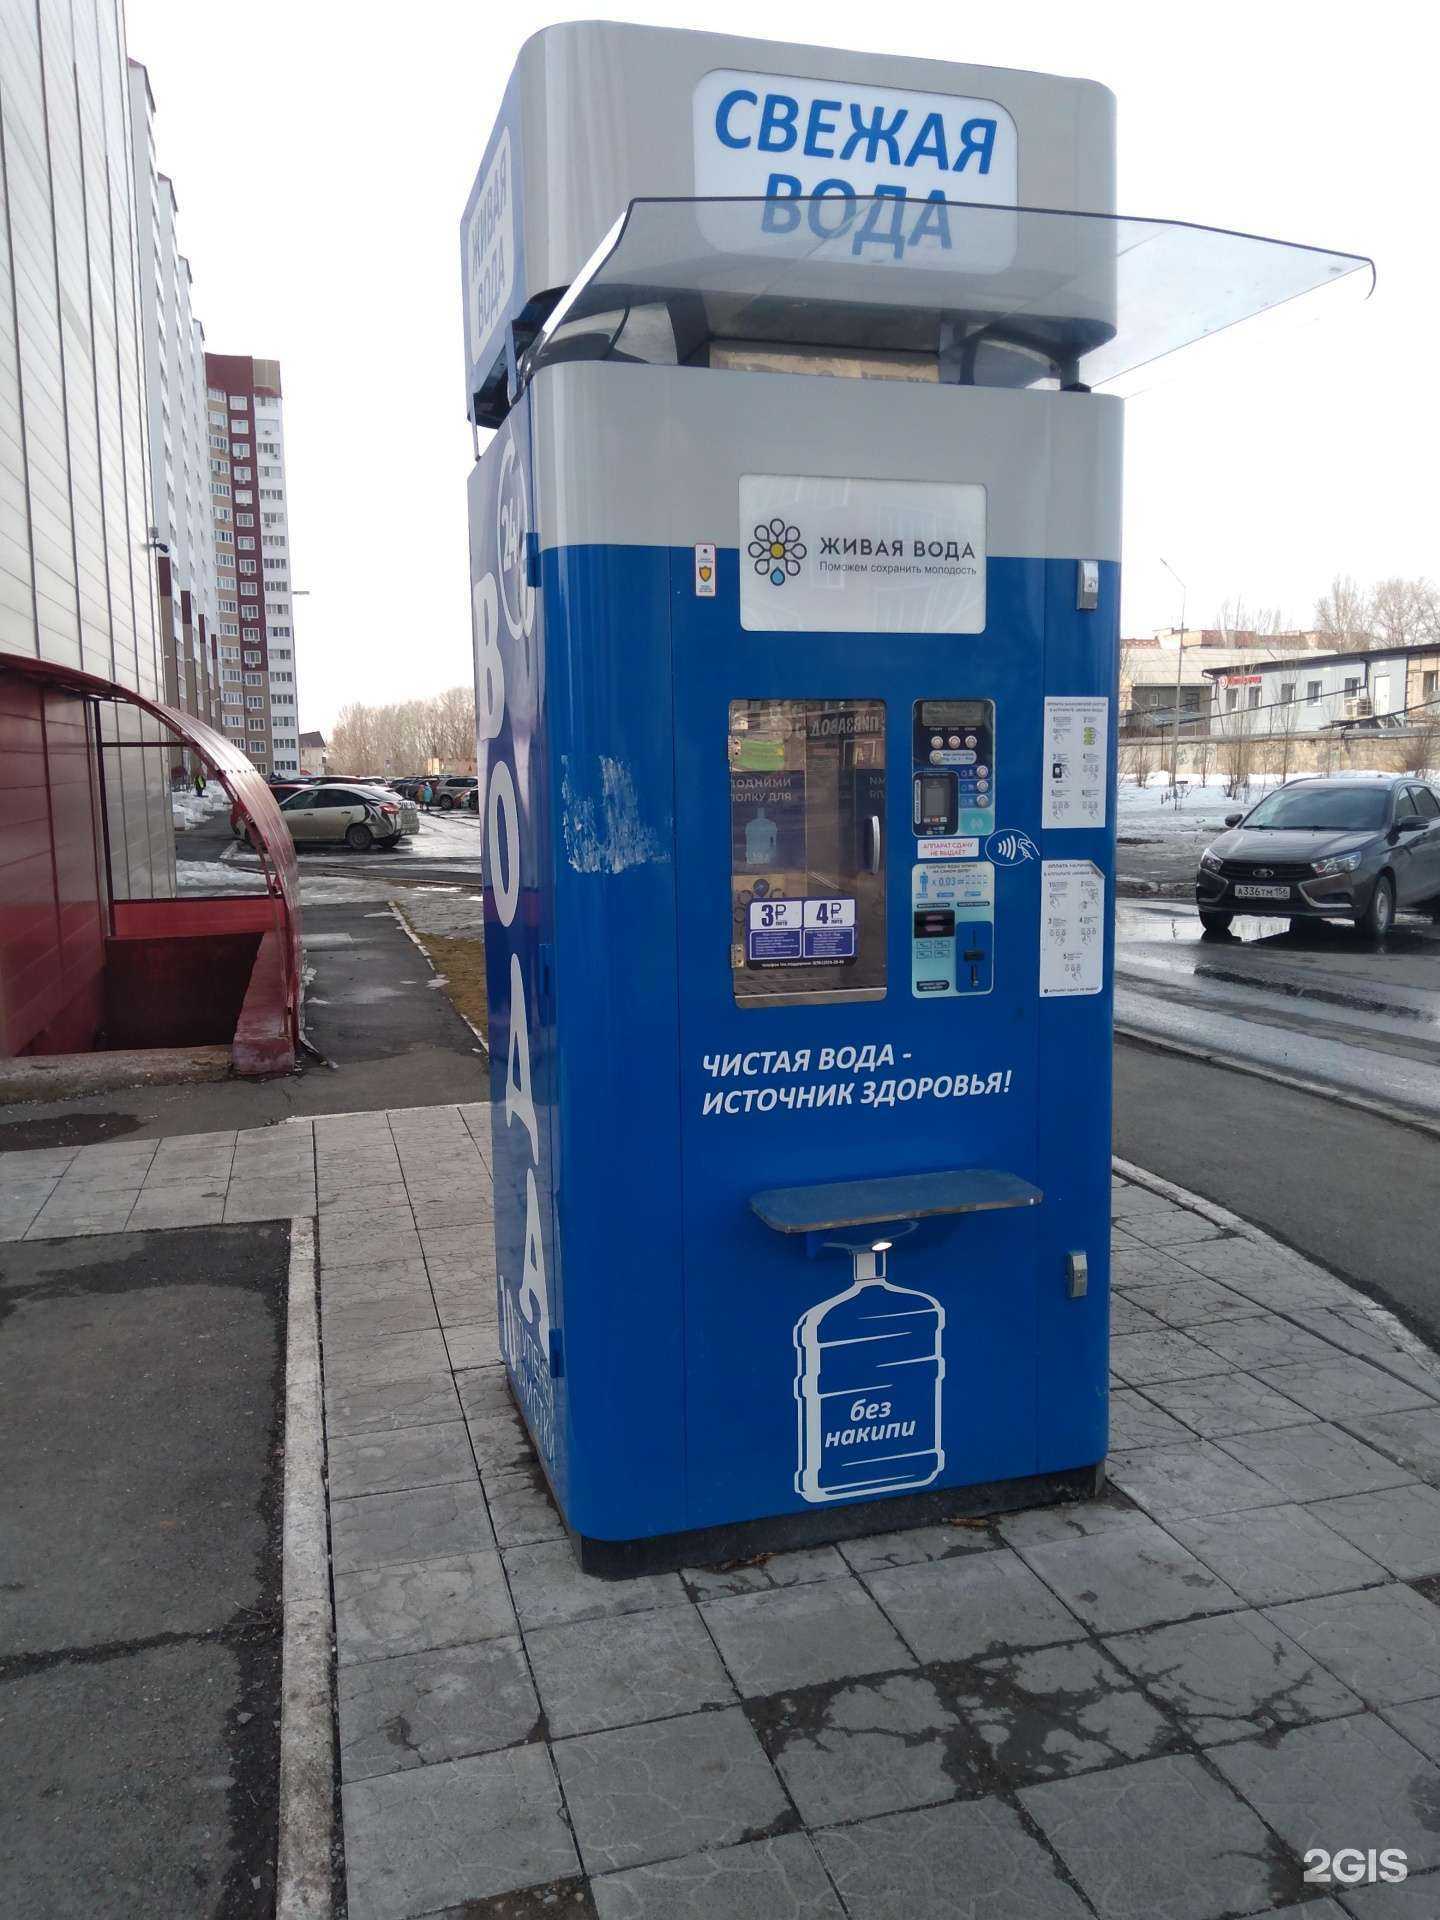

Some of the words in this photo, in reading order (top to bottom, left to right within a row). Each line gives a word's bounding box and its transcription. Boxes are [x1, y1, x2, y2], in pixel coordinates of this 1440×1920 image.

[715, 89, 998, 175] СВЕЖАЯ
[472, 146, 507, 282] ЖИВАЯ
[761, 172, 953, 259] ВОДА
[478, 236, 505, 339] ВОДА
[819, 537, 904, 558] ЖИВАЯ
[913, 540, 976, 562] ВОДА
[819, 561, 868, 573] Поможем
[870, 563, 922, 576] сохранить
[924, 565, 977, 576] молодость
[702, 1049, 812, 1078] ЧИСТАЯ
[818, 1043, 895, 1073] ВОДА
[702, 1082, 853, 1116] ИСТОЧНИК
[859, 1070, 1013, 1108] ЗДОРОВЬЯ!
[850, 1398, 893, 1422] без
[825, 1419, 917, 1448] накипи
